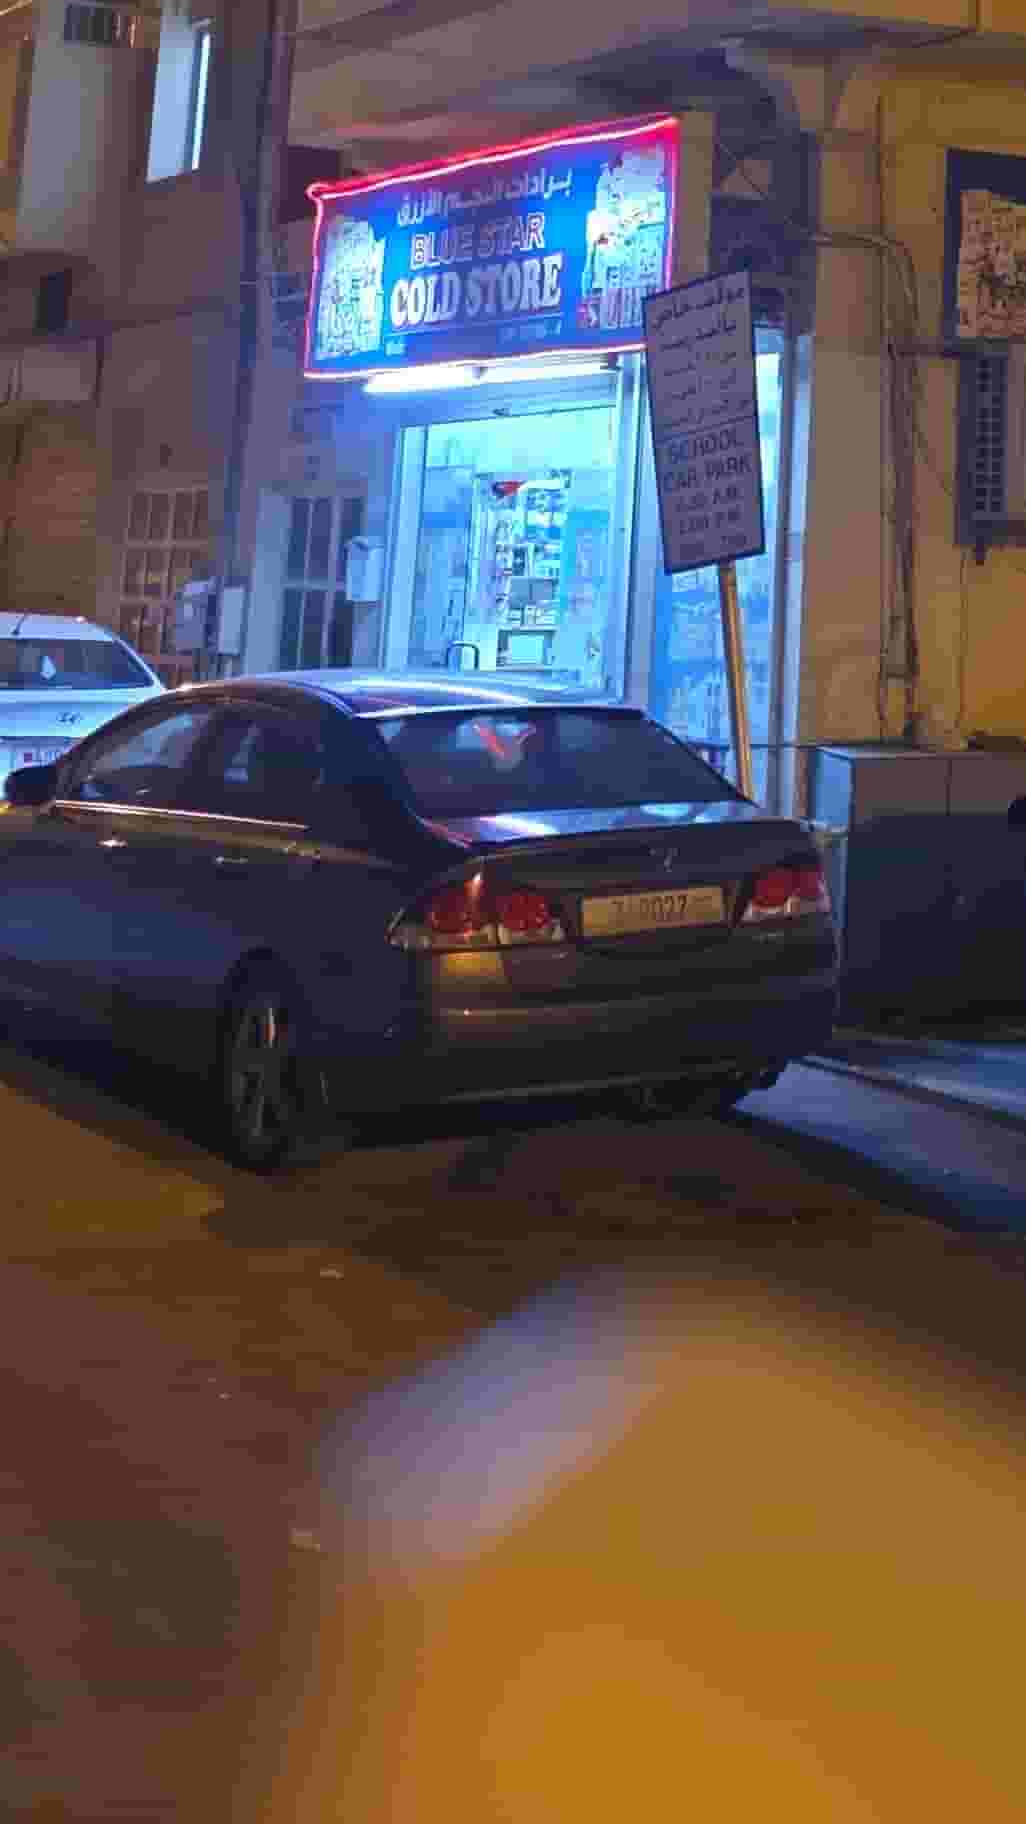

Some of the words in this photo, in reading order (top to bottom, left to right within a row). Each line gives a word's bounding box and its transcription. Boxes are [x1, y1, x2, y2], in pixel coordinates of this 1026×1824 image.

[410, 223, 475, 270] BLUE
[478, 212, 545, 258] STAR
[390, 270, 463, 328] COLD
[466, 253, 564, 317] STORE
[668, 425, 744, 464] SCHOOL
[661, 466, 700, 495] CAR
[704, 450, 752, 483] PARK
